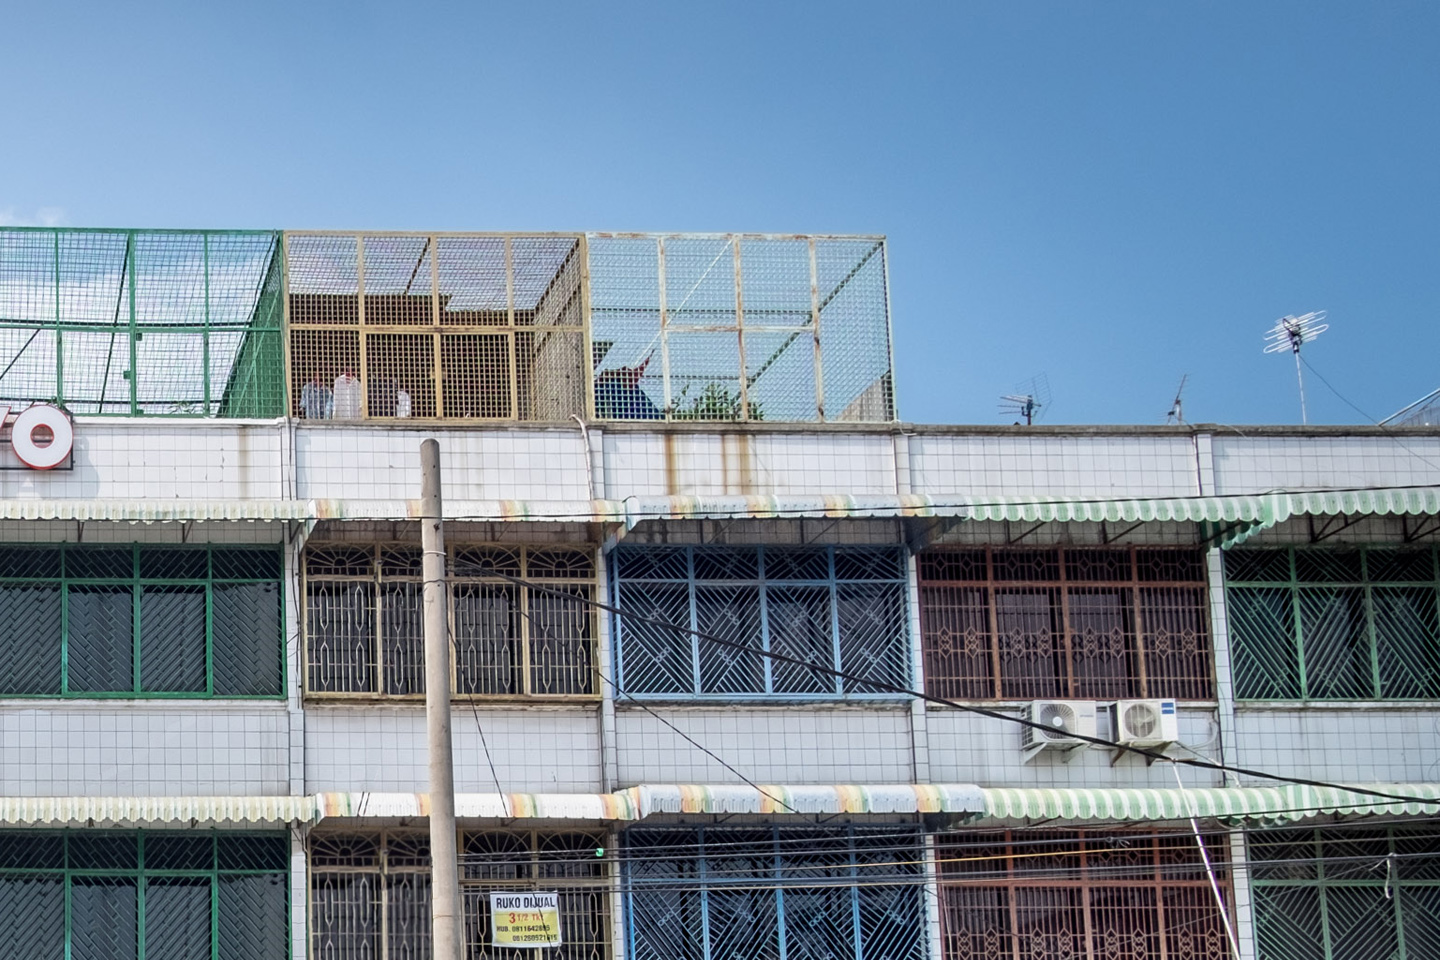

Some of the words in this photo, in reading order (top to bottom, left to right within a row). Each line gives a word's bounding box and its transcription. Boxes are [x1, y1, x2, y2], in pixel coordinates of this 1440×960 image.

[496, 897, 521, 909] RUKO
[524, 896, 556, 909] DIJUAL
[509, 912, 516, 924] 3
